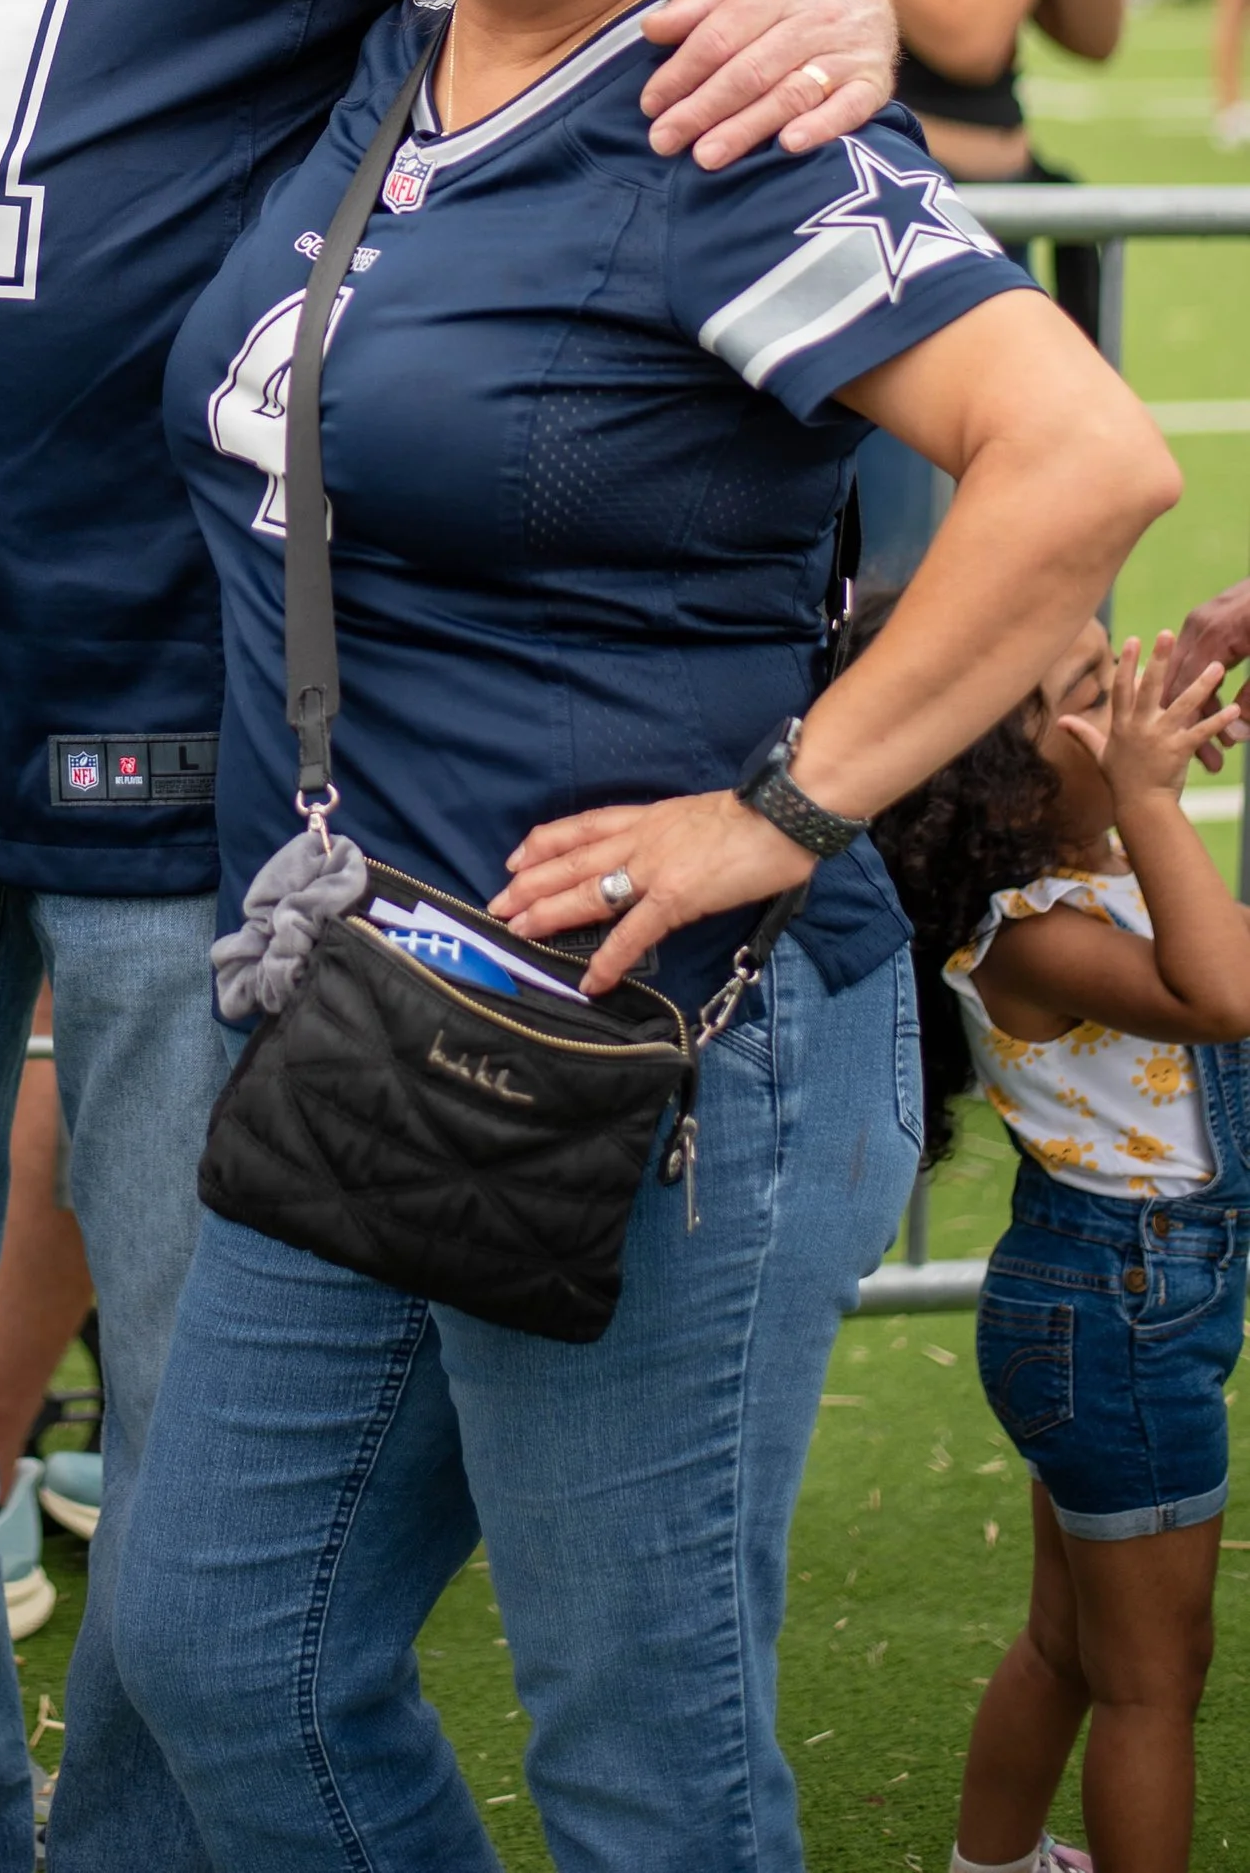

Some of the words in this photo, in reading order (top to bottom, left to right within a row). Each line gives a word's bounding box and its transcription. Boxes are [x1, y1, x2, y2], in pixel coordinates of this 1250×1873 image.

[387, 173, 416, 203] NFL
[178, 745, 199, 770] L
[72, 768, 95, 786] NFL
